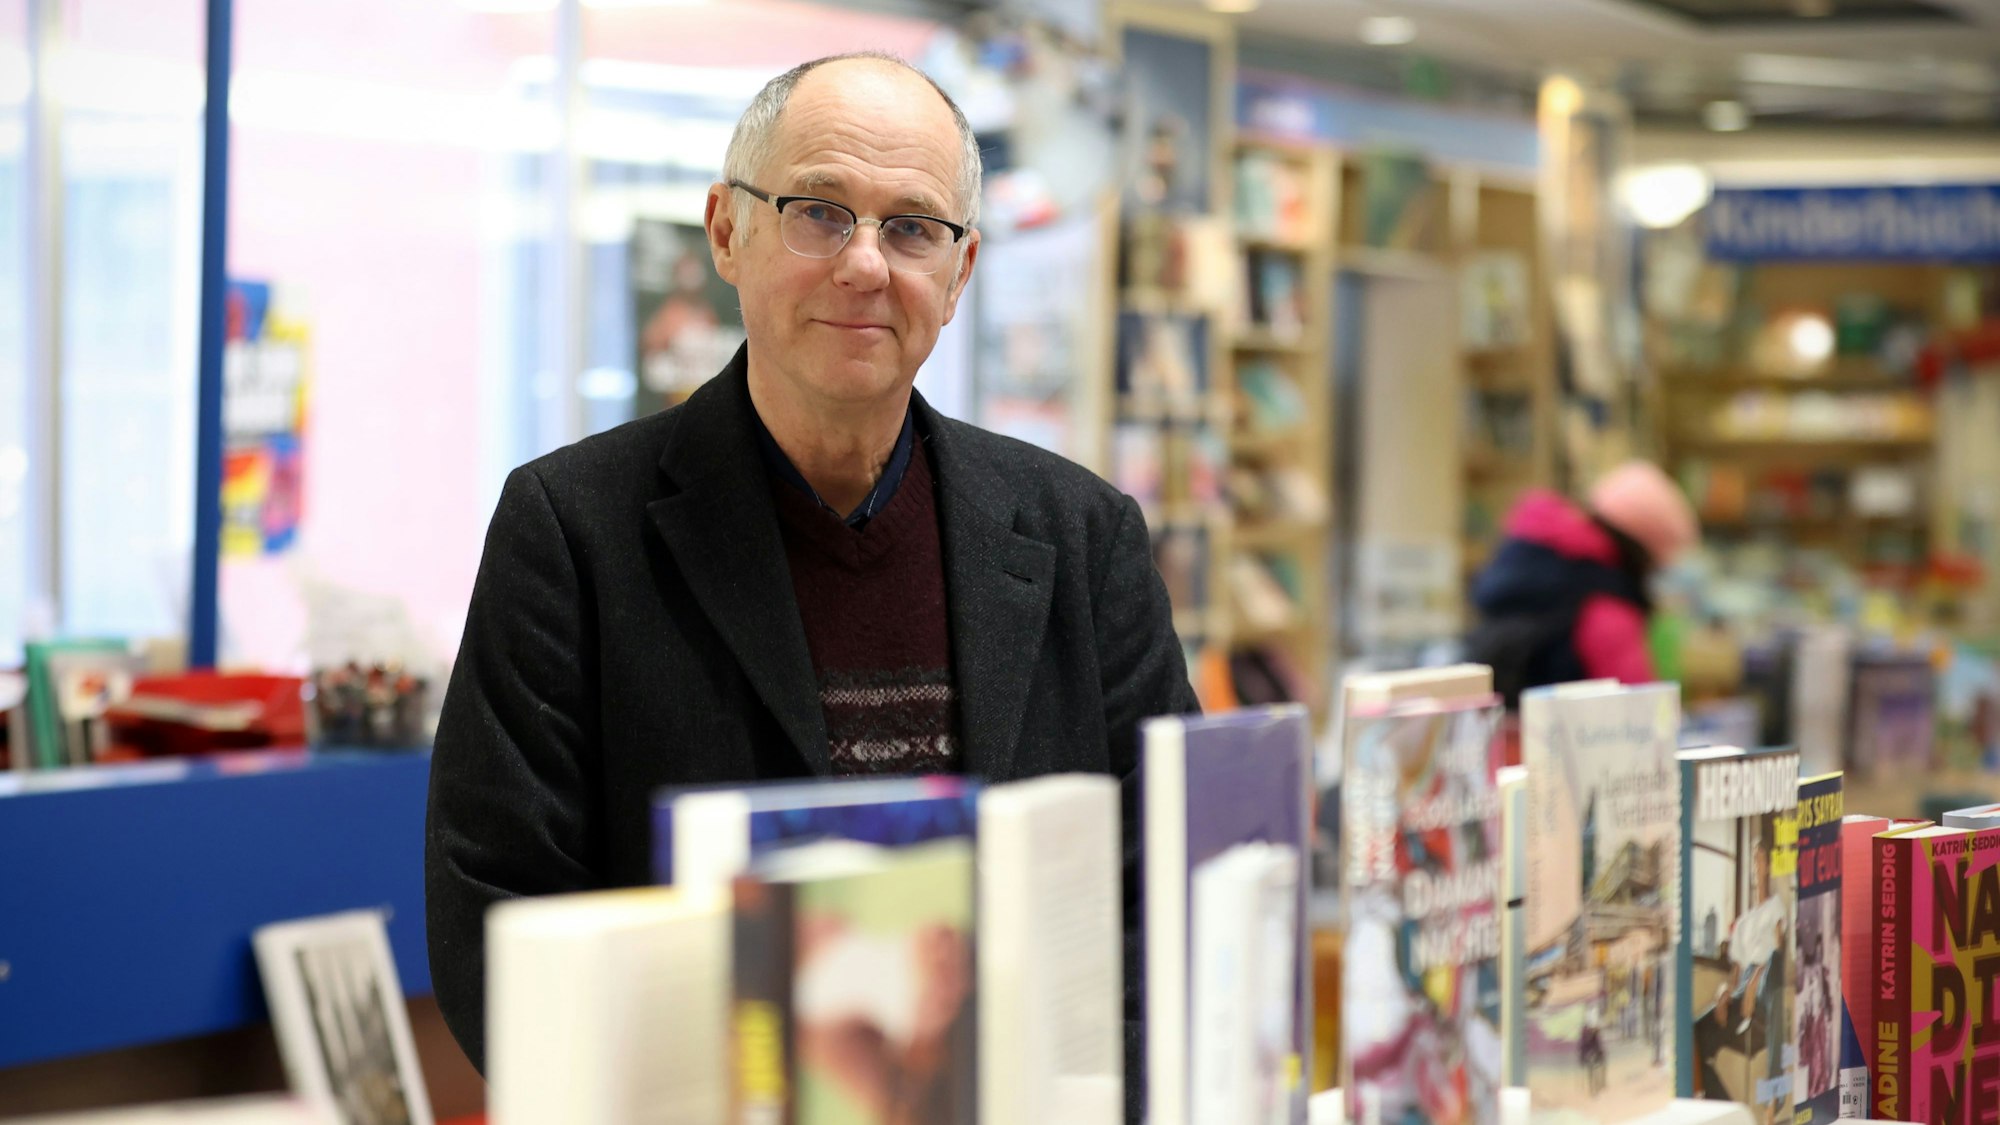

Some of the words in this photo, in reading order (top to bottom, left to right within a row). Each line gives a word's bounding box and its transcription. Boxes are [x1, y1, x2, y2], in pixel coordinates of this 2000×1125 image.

[1797, 797, 1814, 831] RIS
[1931, 838, 1970, 857] KATRIN
[1971, 834, 2000, 852] SEDDI
[1881, 843, 1897, 917] SEDDIG
[1932, 856, 2000, 956] NA
[1880, 922, 1897, 1000] KATRIN
[1878, 1021, 1899, 1120] ADINE
